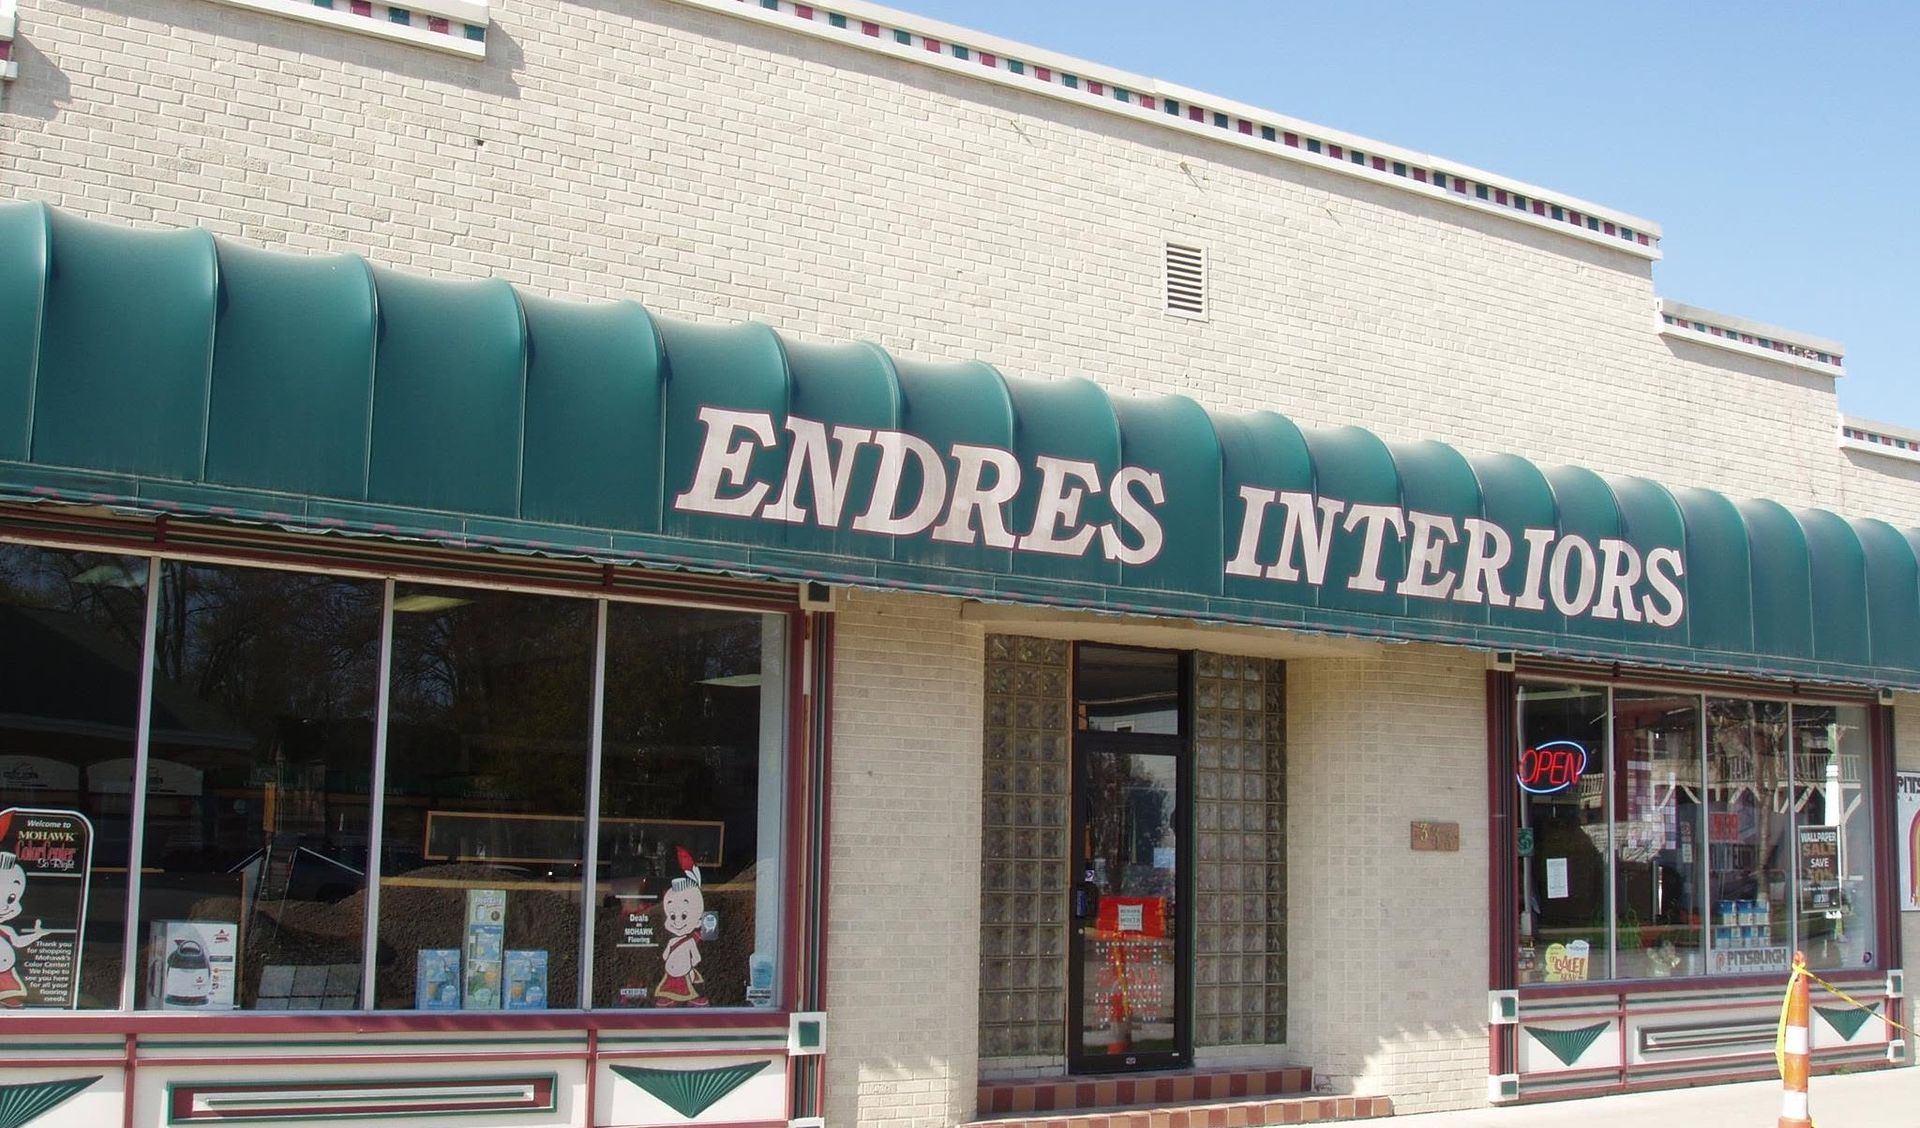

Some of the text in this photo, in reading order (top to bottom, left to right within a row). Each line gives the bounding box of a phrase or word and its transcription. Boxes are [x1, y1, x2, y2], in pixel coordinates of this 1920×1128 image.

[675, 406, 1687, 628] ENDRES INTERIORS
[1519, 749, 1583, 784] OPEN
[27, 819, 72, 829] Welcome to
[18, 830, 75, 841] MOHAWK
[1800, 831, 1837, 843] WALLPAPER
[1803, 842, 1836, 856] SALE
[1810, 858, 1830, 868] SAVE
[629, 913, 649, 922] Deals
[624, 927, 654, 936] MOHAWK
[628, 936, 651, 944] Flooring
[39, 947, 72, 955] shopping
[59, 942, 73, 950] you
[1727, 949, 1787, 966] PITTSBURGH
[42, 968, 60, 976] hope
